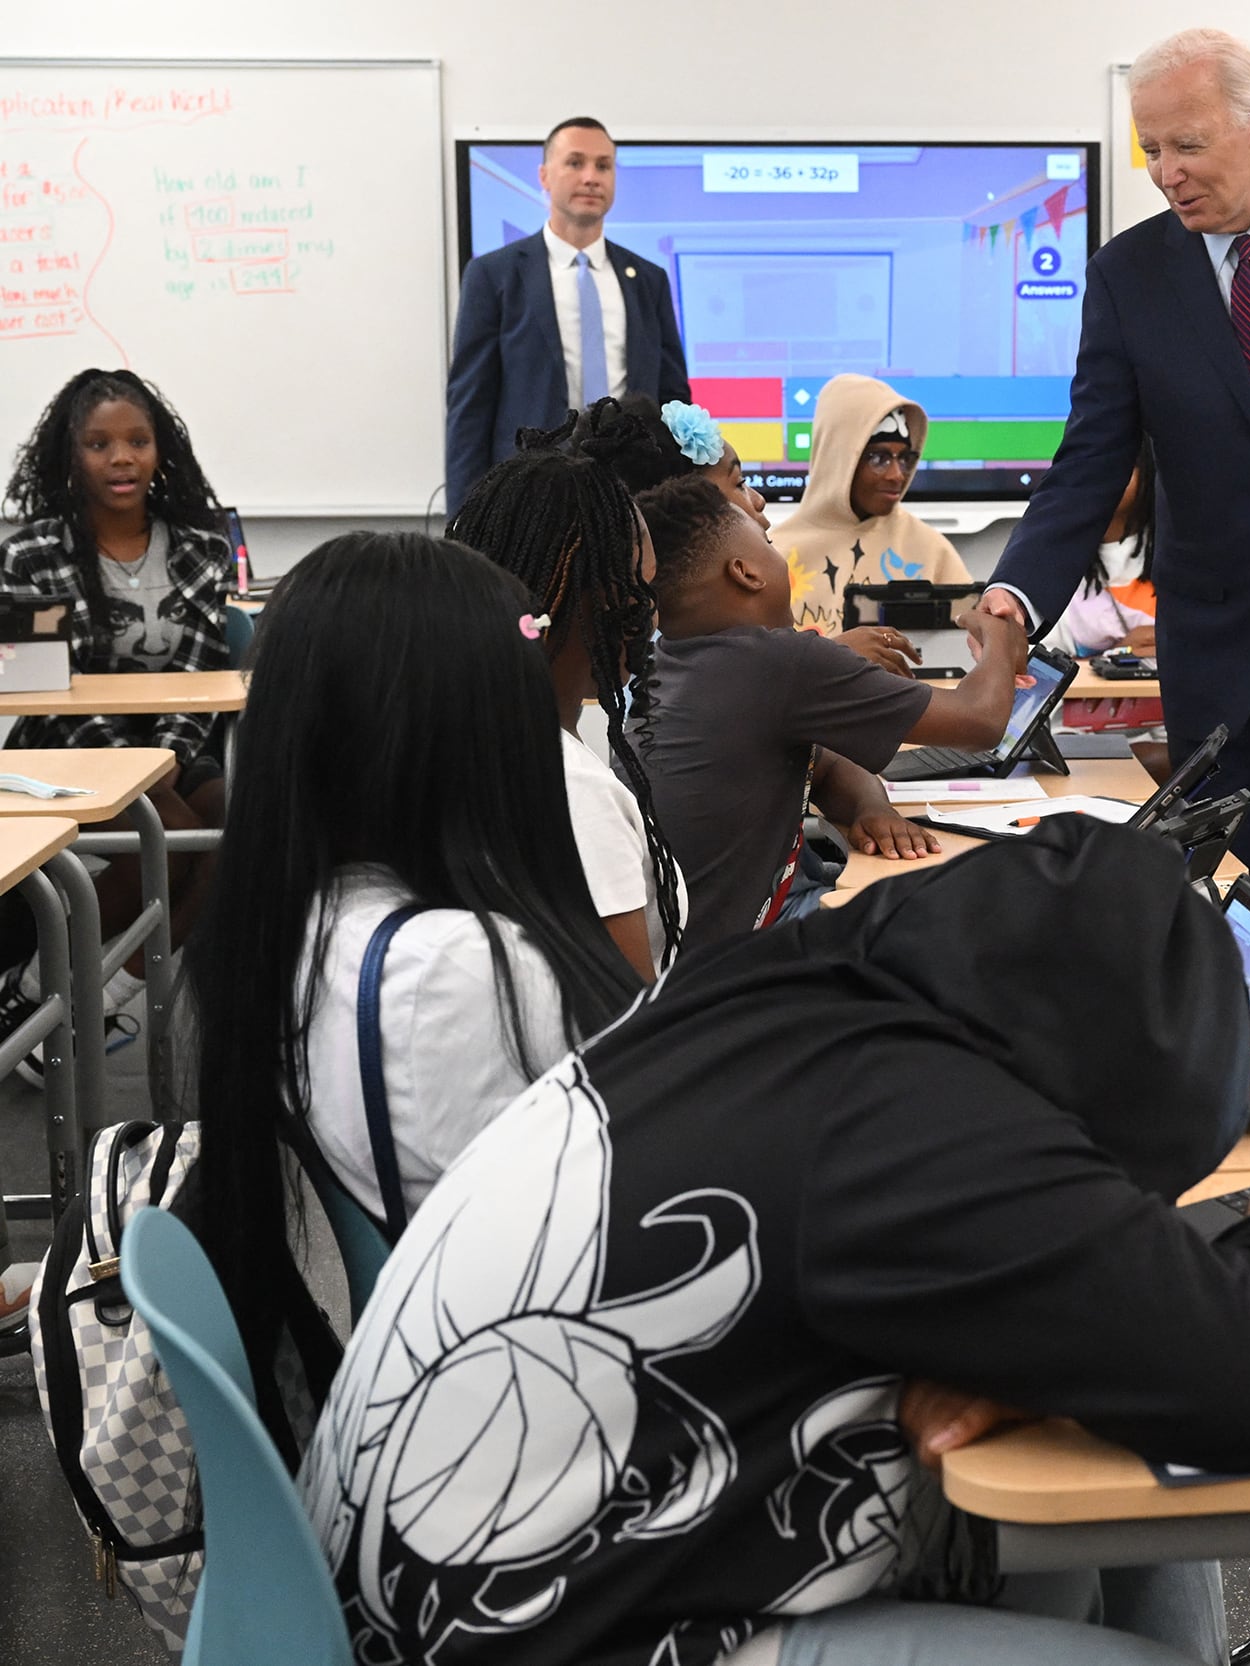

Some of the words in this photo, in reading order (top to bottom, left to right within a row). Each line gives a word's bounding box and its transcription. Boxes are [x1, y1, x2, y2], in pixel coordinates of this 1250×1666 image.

[153, 165, 194, 192] How
[204, 168, 237, 192] old
[249, 174, 282, 190] am
[296, 164, 311, 188] I
[723, 166, 750, 181] -20
[767, 166, 792, 181] -36
[808, 166, 840, 184] 32p
[163, 234, 191, 271] by
[295, 238, 336, 261] my
[1039, 253, 1054, 271] 2
[1019, 284, 1075, 298] Answers
[766, 474, 803, 488] Game
